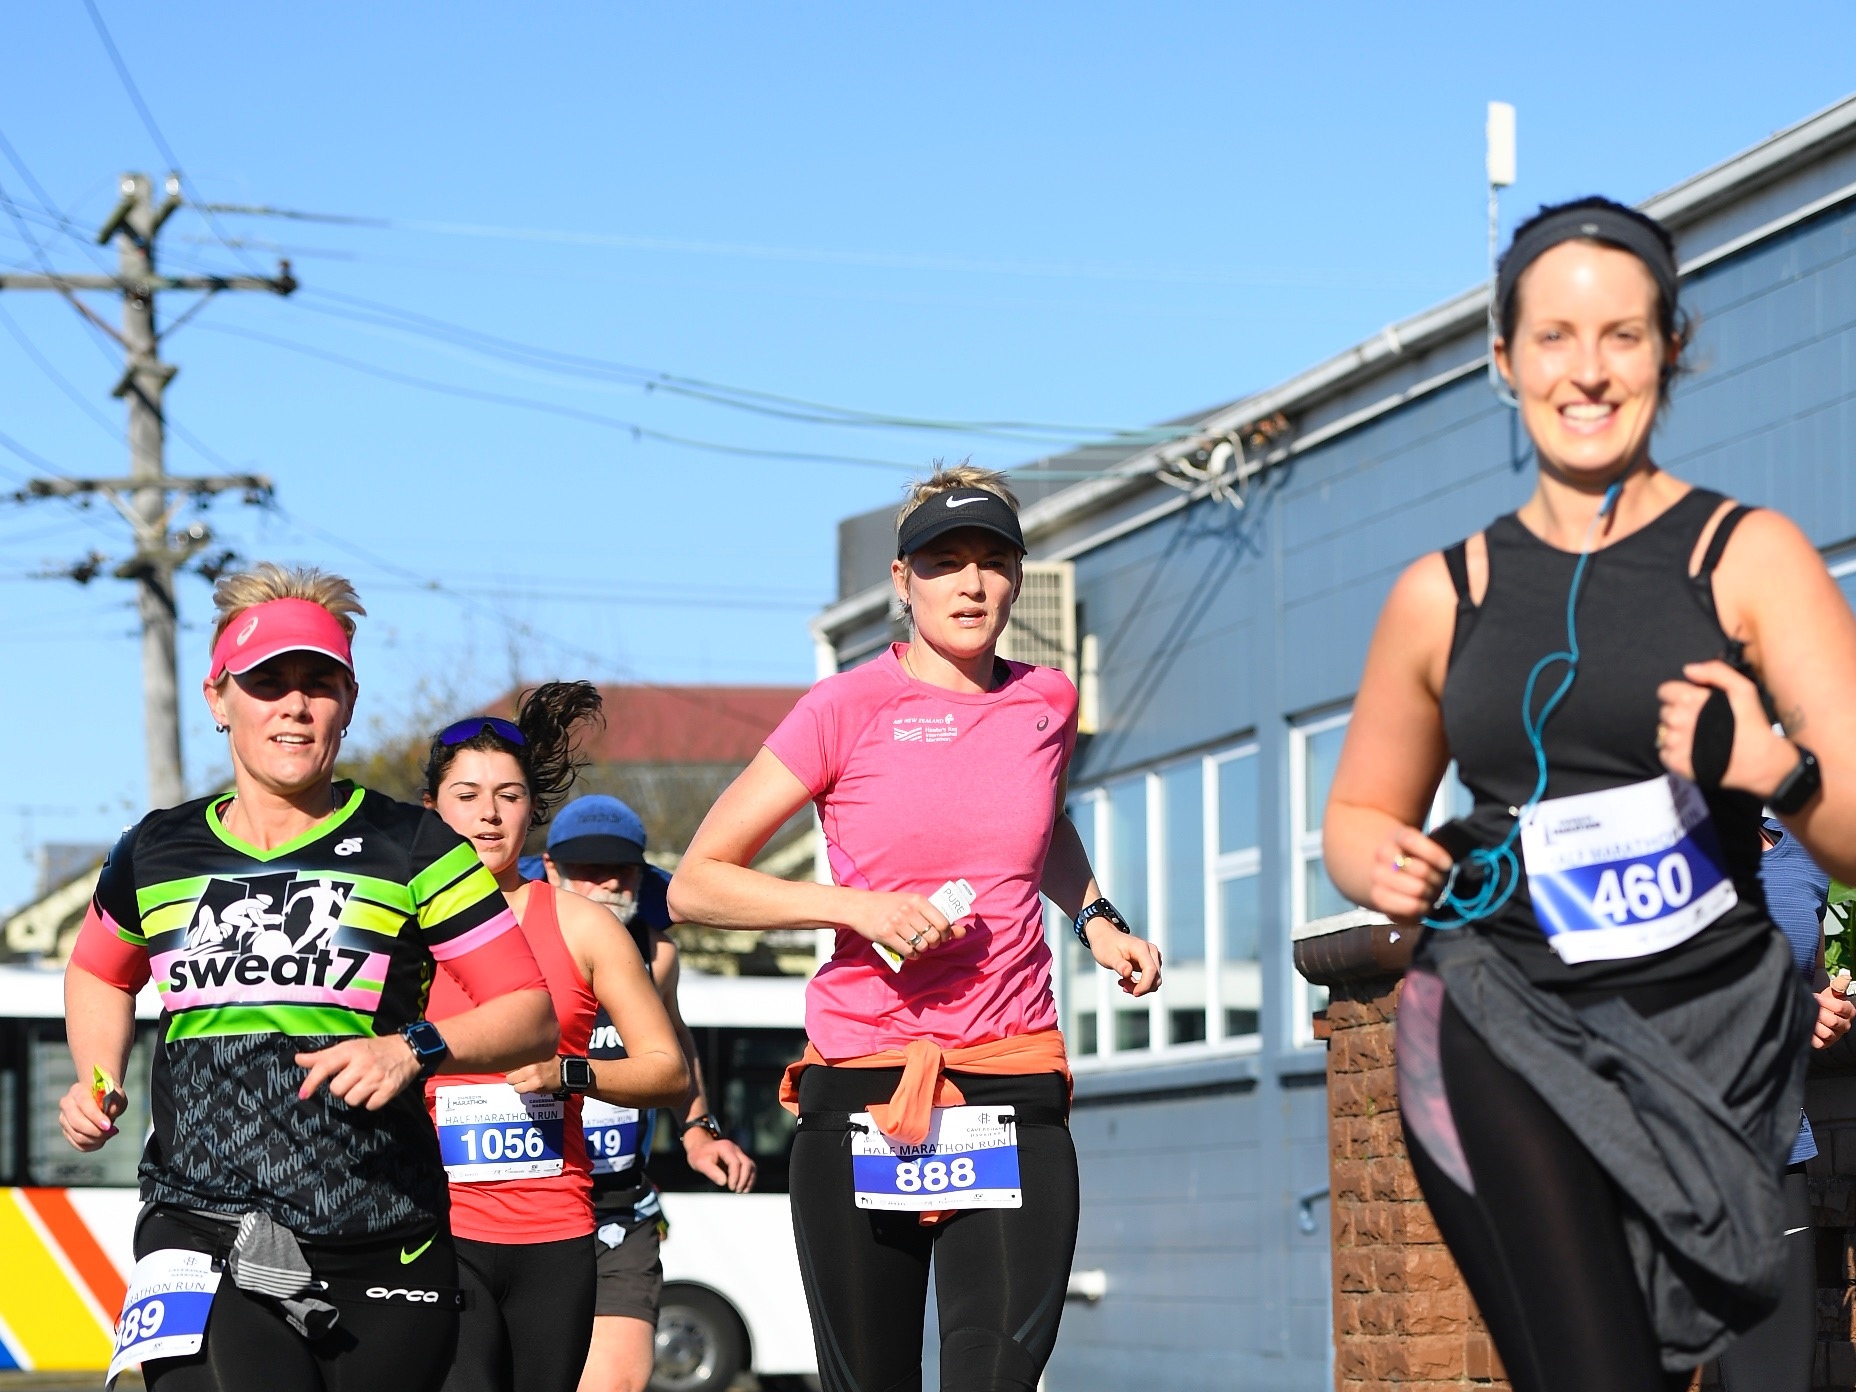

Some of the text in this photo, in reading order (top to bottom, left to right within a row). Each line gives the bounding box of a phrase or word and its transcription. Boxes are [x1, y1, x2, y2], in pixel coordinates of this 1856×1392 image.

[943, 888, 965, 915] PURE
[1591, 851, 1693, 924] 460
[169, 947, 371, 993] sweat7
[445, 1110, 558, 1124] HALF MARATHON RUN
[460, 1127, 544, 1161] 1056
[588, 1128, 622, 1157] 19
[863, 1138, 1007, 1156] HALF MARATHON RUN
[895, 1157, 976, 1192] 888
[175, 1281, 206, 1291] RUN
[365, 1286, 439, 1303] orca
